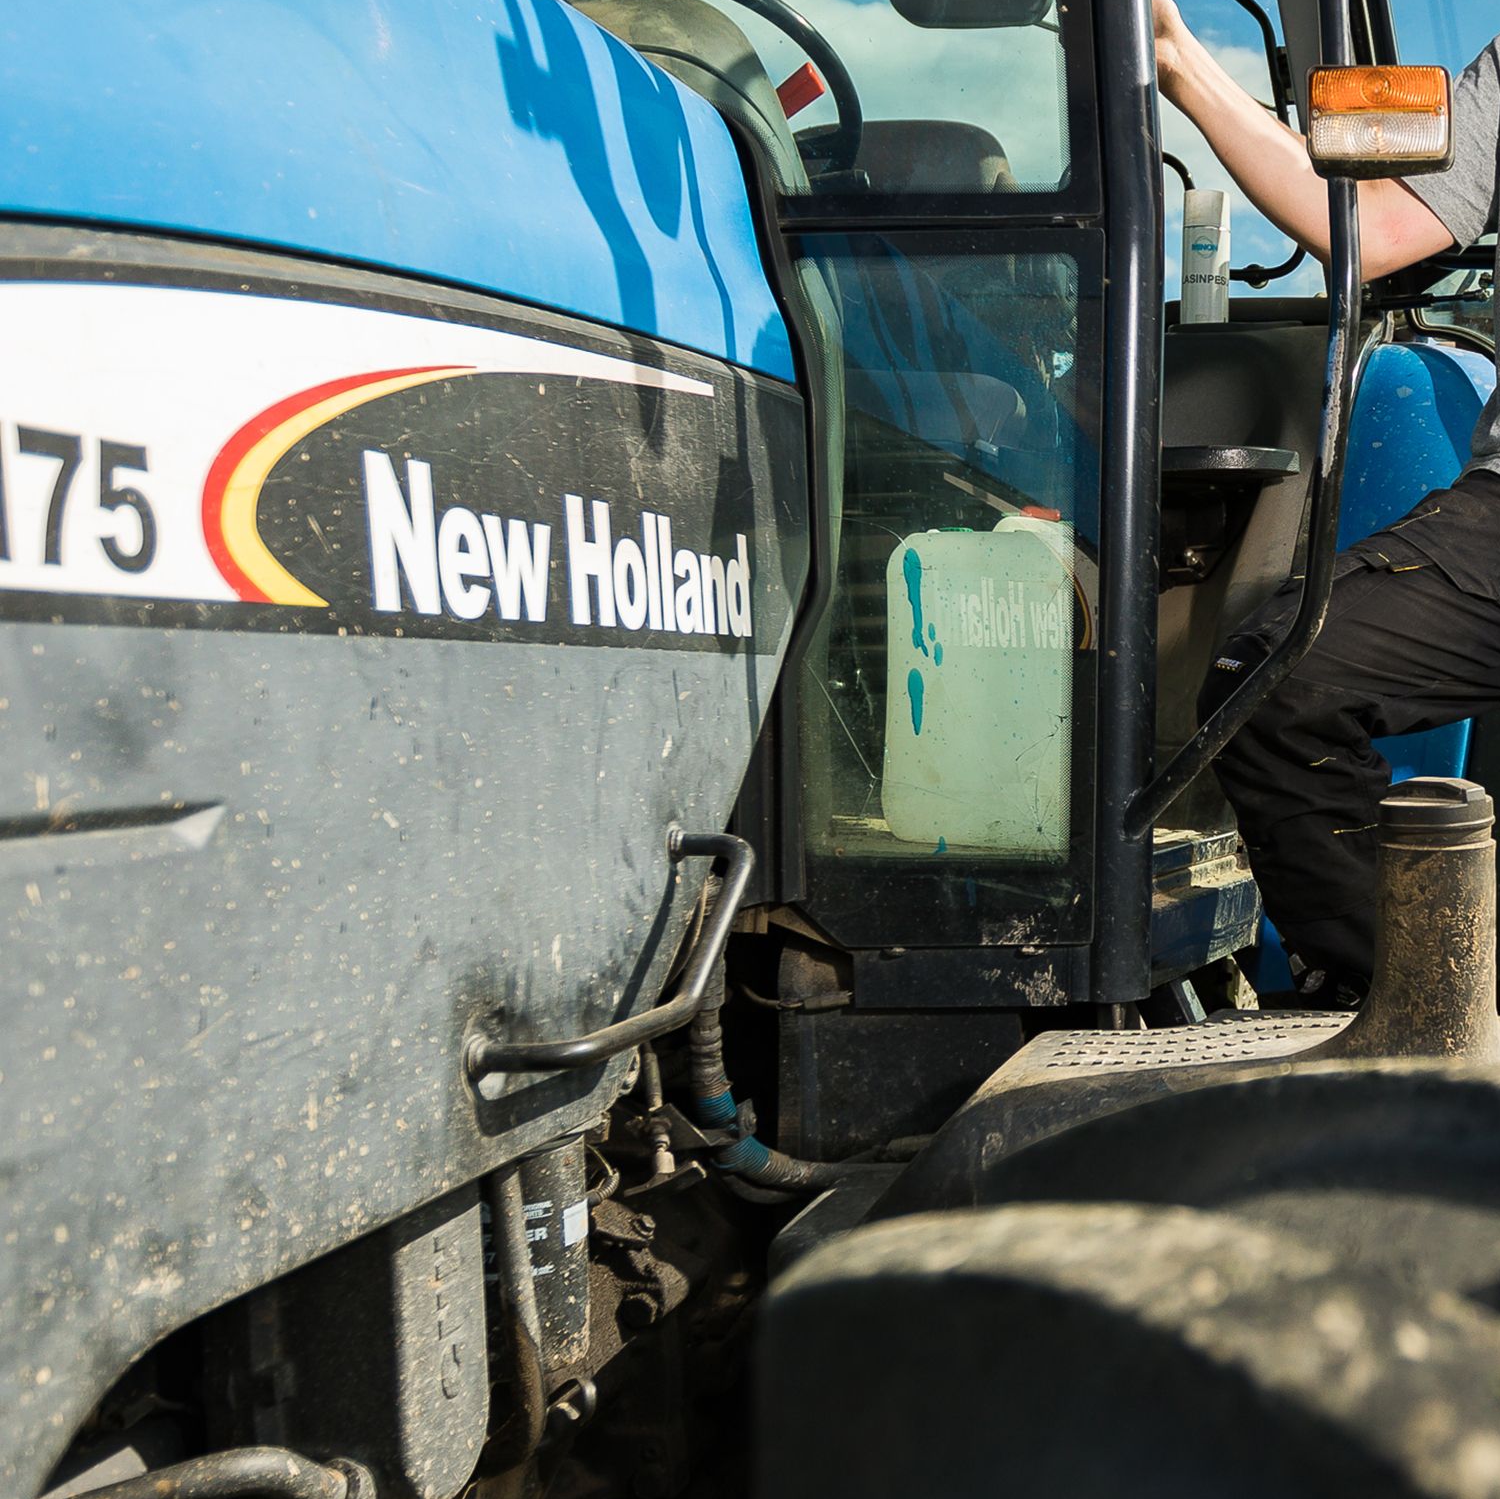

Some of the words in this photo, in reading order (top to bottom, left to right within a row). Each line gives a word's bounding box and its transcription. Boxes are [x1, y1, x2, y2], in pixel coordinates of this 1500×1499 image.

[1182, 273, 1229, 287] ASINPES
[362, 450, 551, 622] New
[564, 494, 752, 638] Holland
